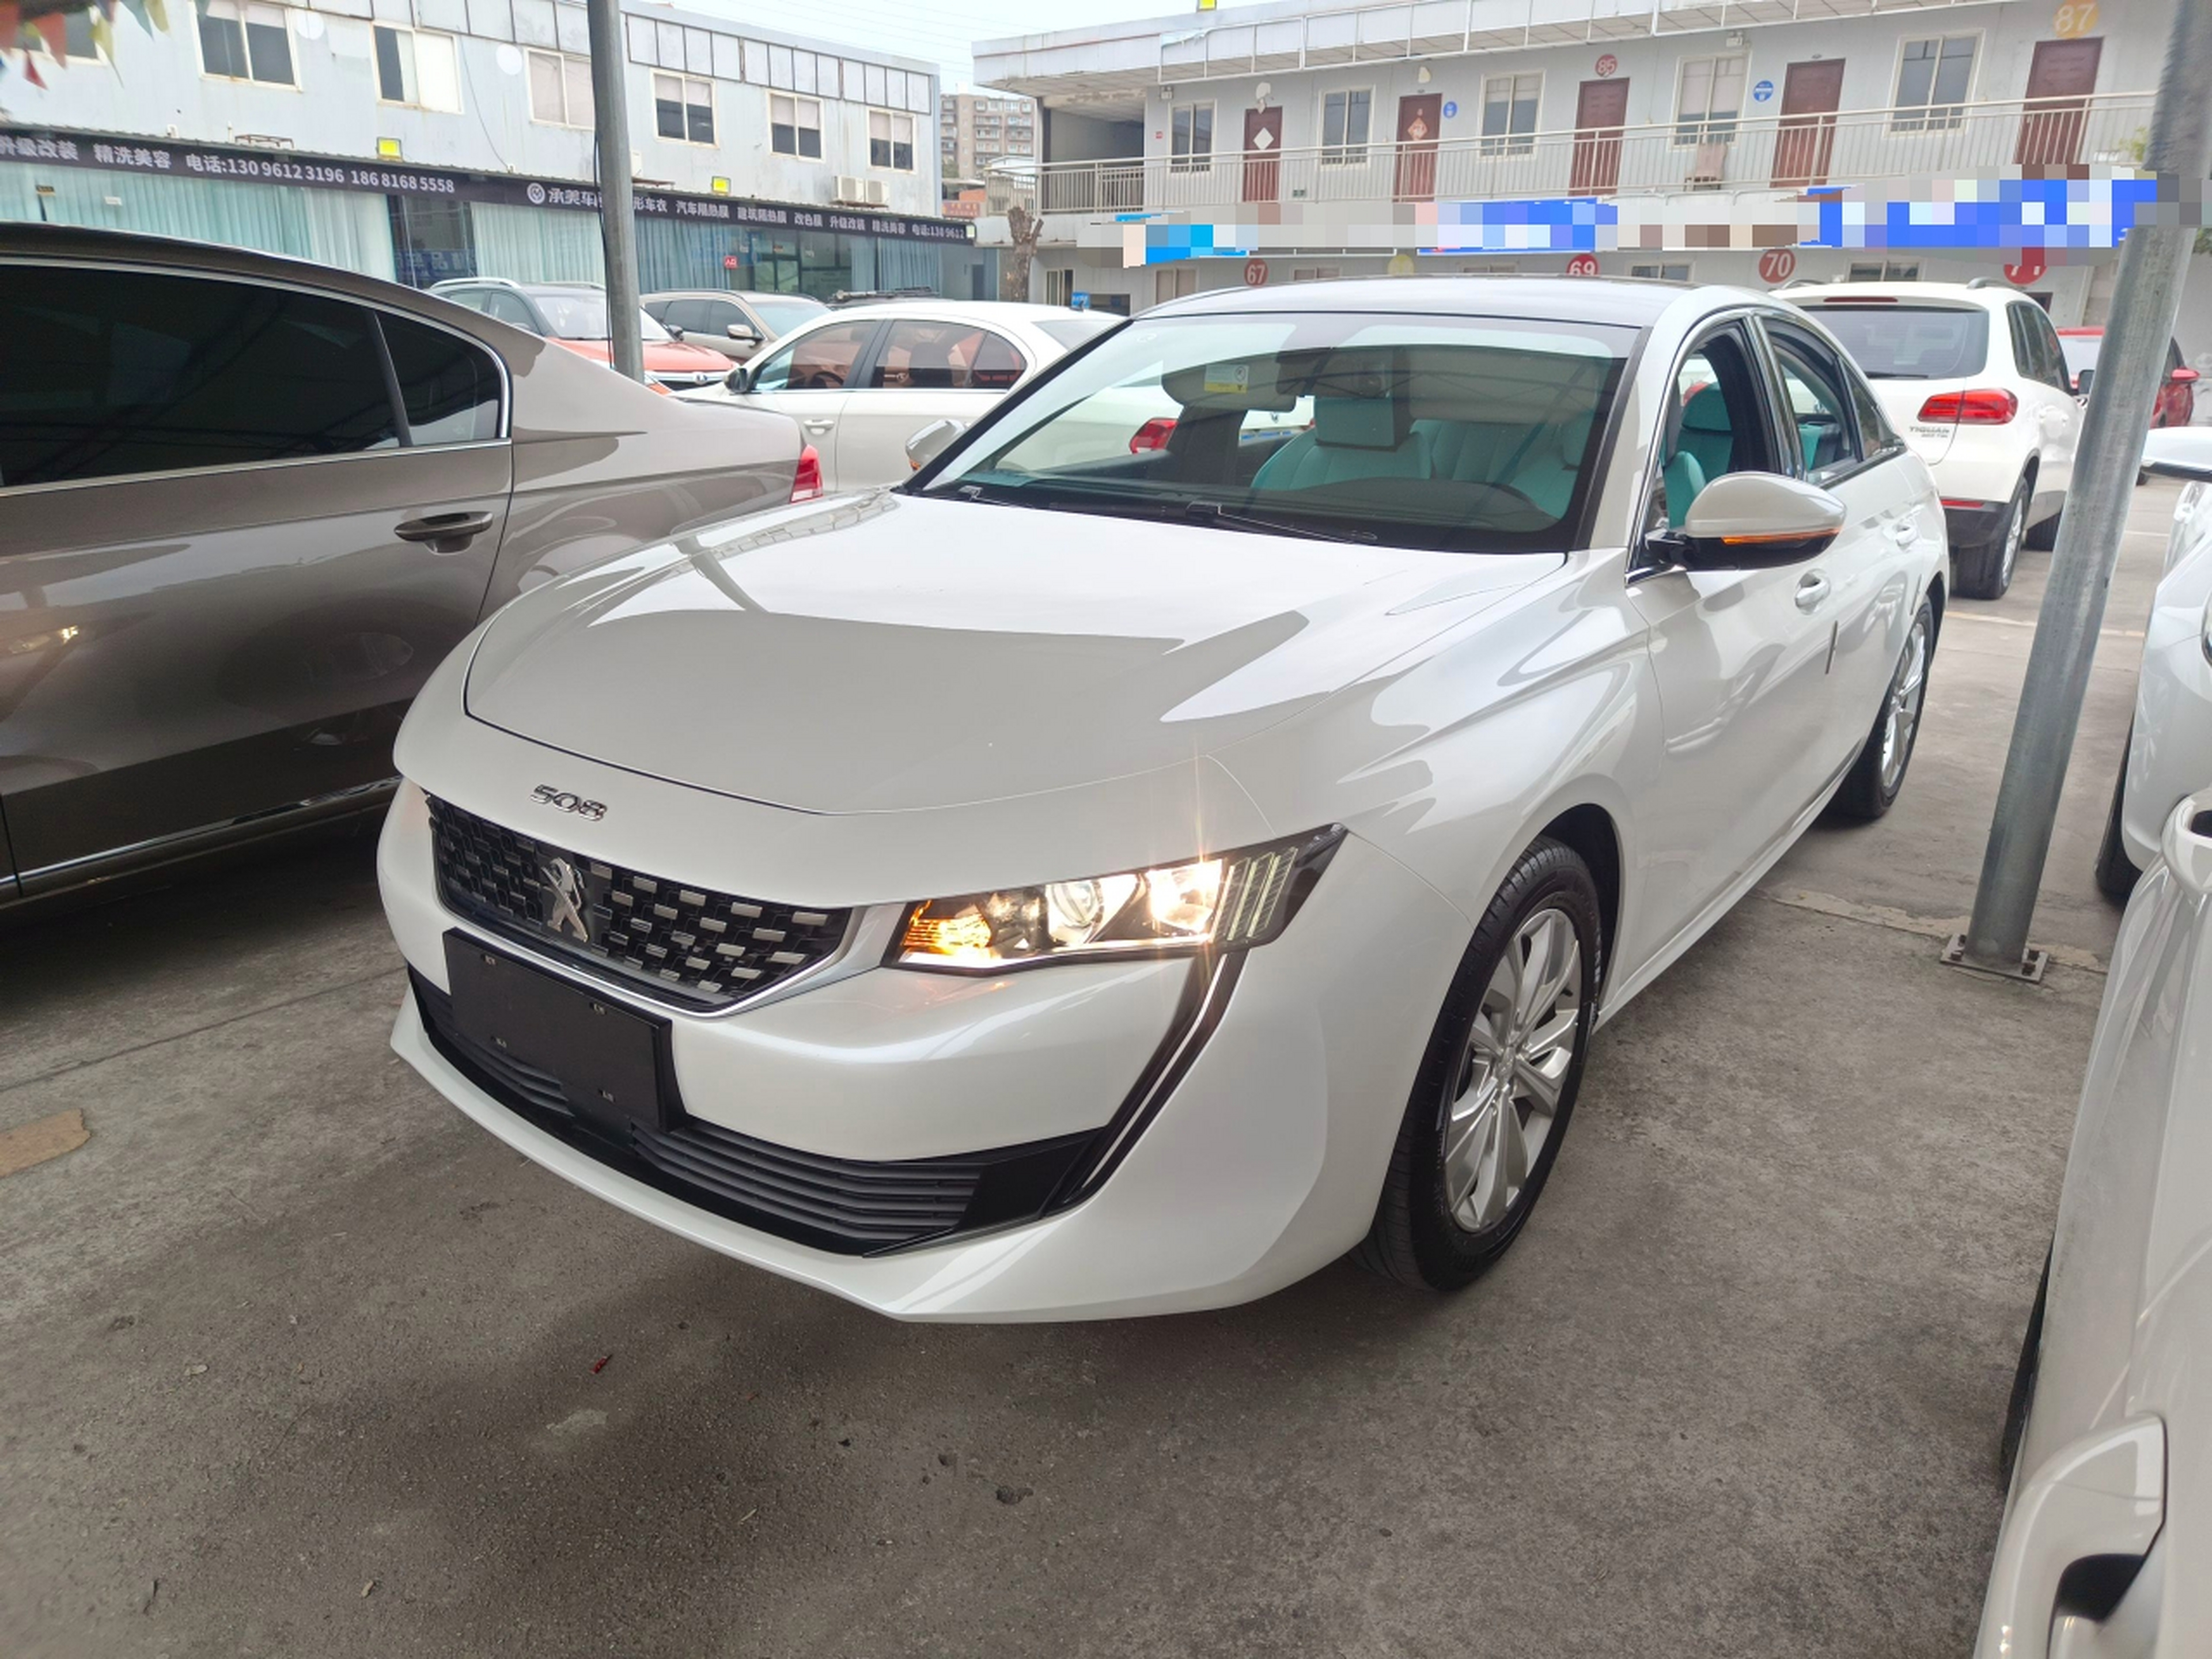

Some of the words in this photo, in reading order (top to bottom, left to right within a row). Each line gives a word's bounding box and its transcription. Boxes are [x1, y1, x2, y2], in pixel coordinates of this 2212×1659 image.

[2054, 2, 2097, 33] 87
[1597, 58, 1615, 74] 85
[93, 143, 172, 169] 精洗美容
[634, 196, 668, 213] 形车衣
[1247, 263, 1266, 285] 67
[1569, 260, 1596, 276] 69
[1766, 252, 1791, 278] 70
[529, 783, 608, 822] 508
